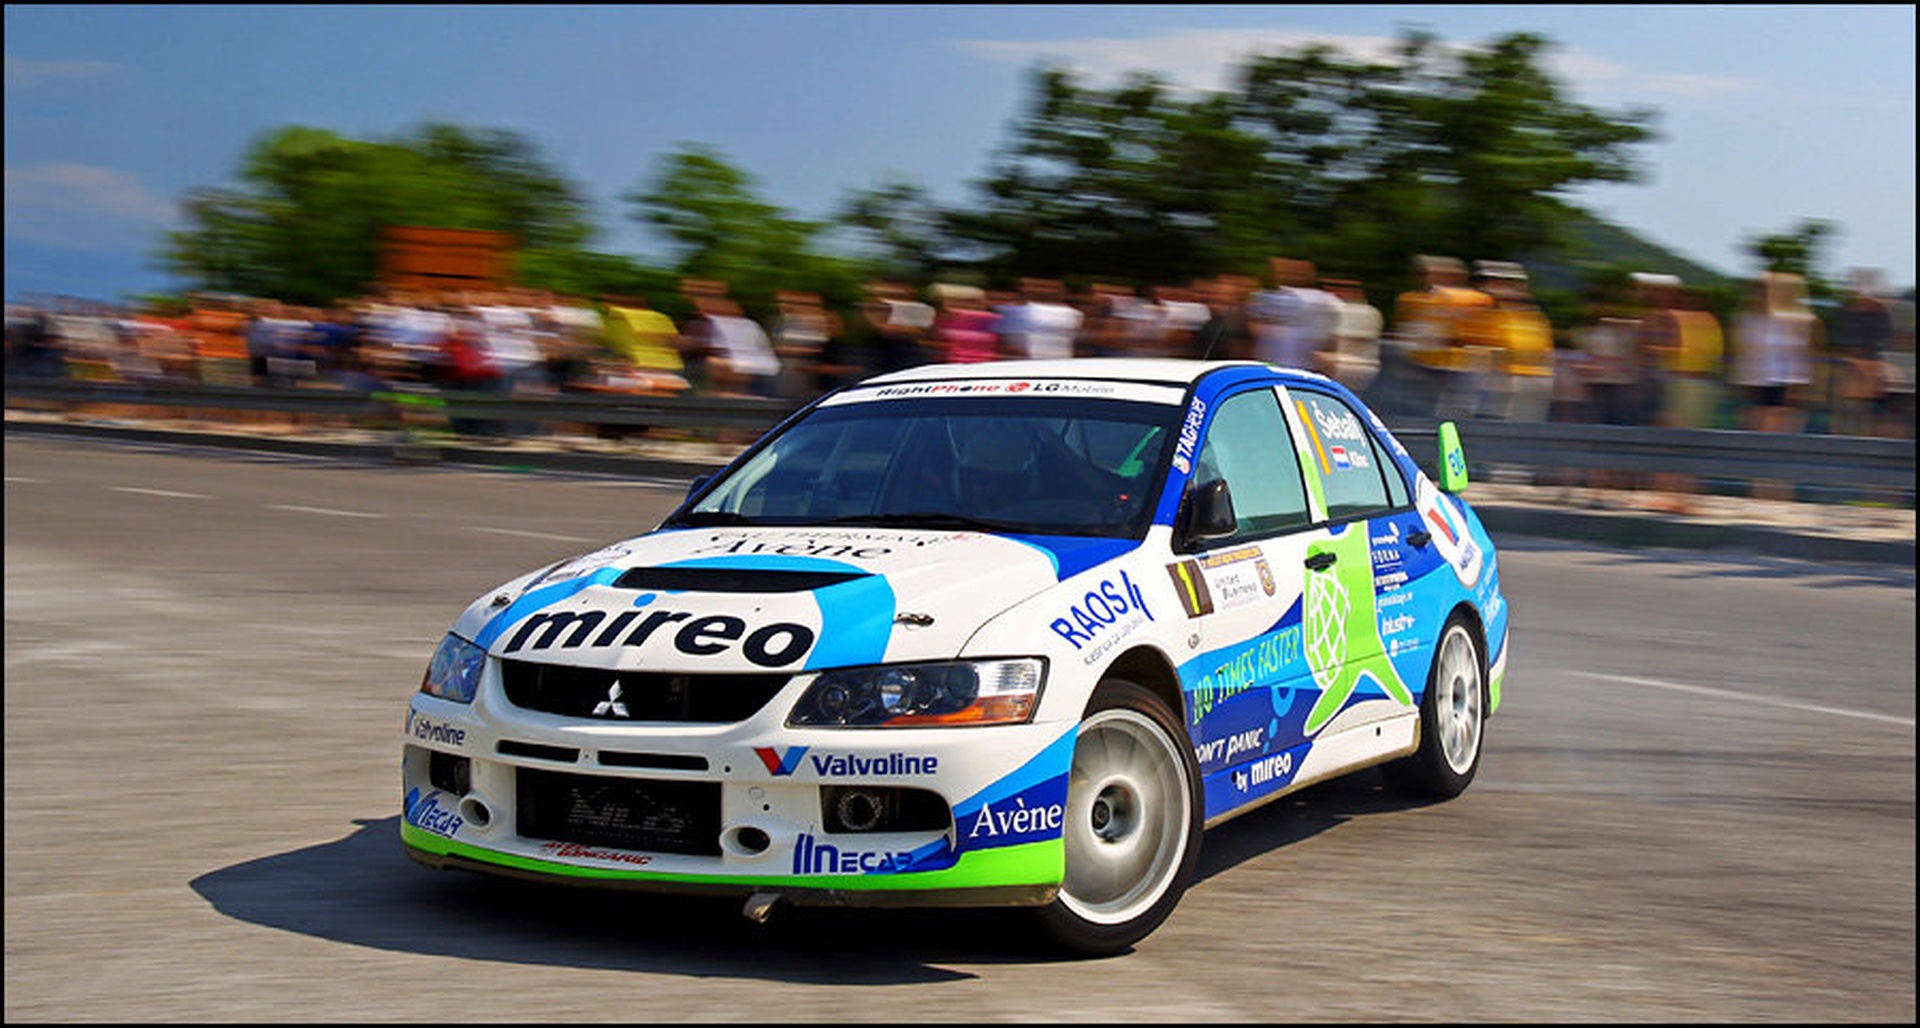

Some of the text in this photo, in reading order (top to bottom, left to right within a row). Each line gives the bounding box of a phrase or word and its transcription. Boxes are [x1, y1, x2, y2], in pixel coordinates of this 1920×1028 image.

[503, 592, 815, 668] mireo
[1257, 627, 1300, 680] FASTER
[811, 752, 938, 776] Valvoline
[1225, 727, 1264, 765] PANIC
[1236, 752, 1292, 793] by mireo
[969, 797, 1063, 838] Avène
